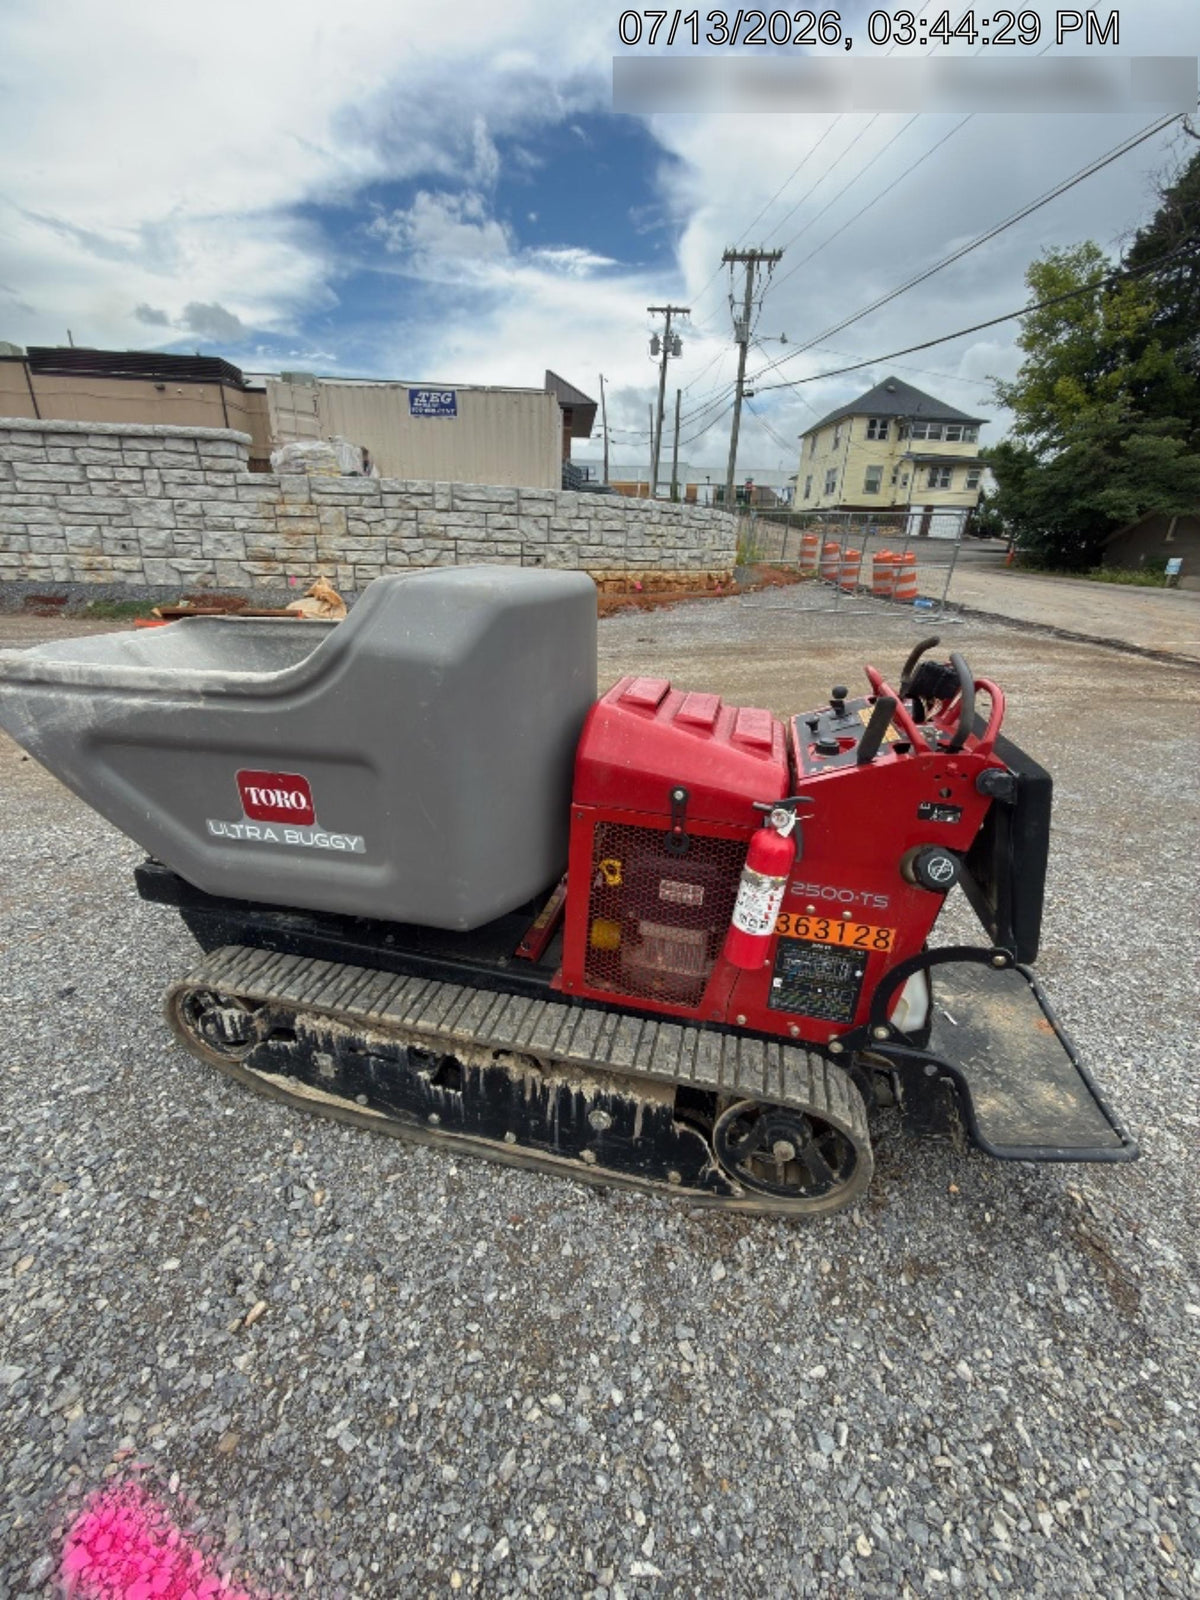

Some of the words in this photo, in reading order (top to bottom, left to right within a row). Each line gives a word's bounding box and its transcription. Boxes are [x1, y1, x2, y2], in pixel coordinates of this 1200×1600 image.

[244, 786, 308, 810] TORO
[208, 821, 279, 842] ULTRA
[284, 829, 359, 851] BUGGY
[775, 913, 891, 950] 363128
